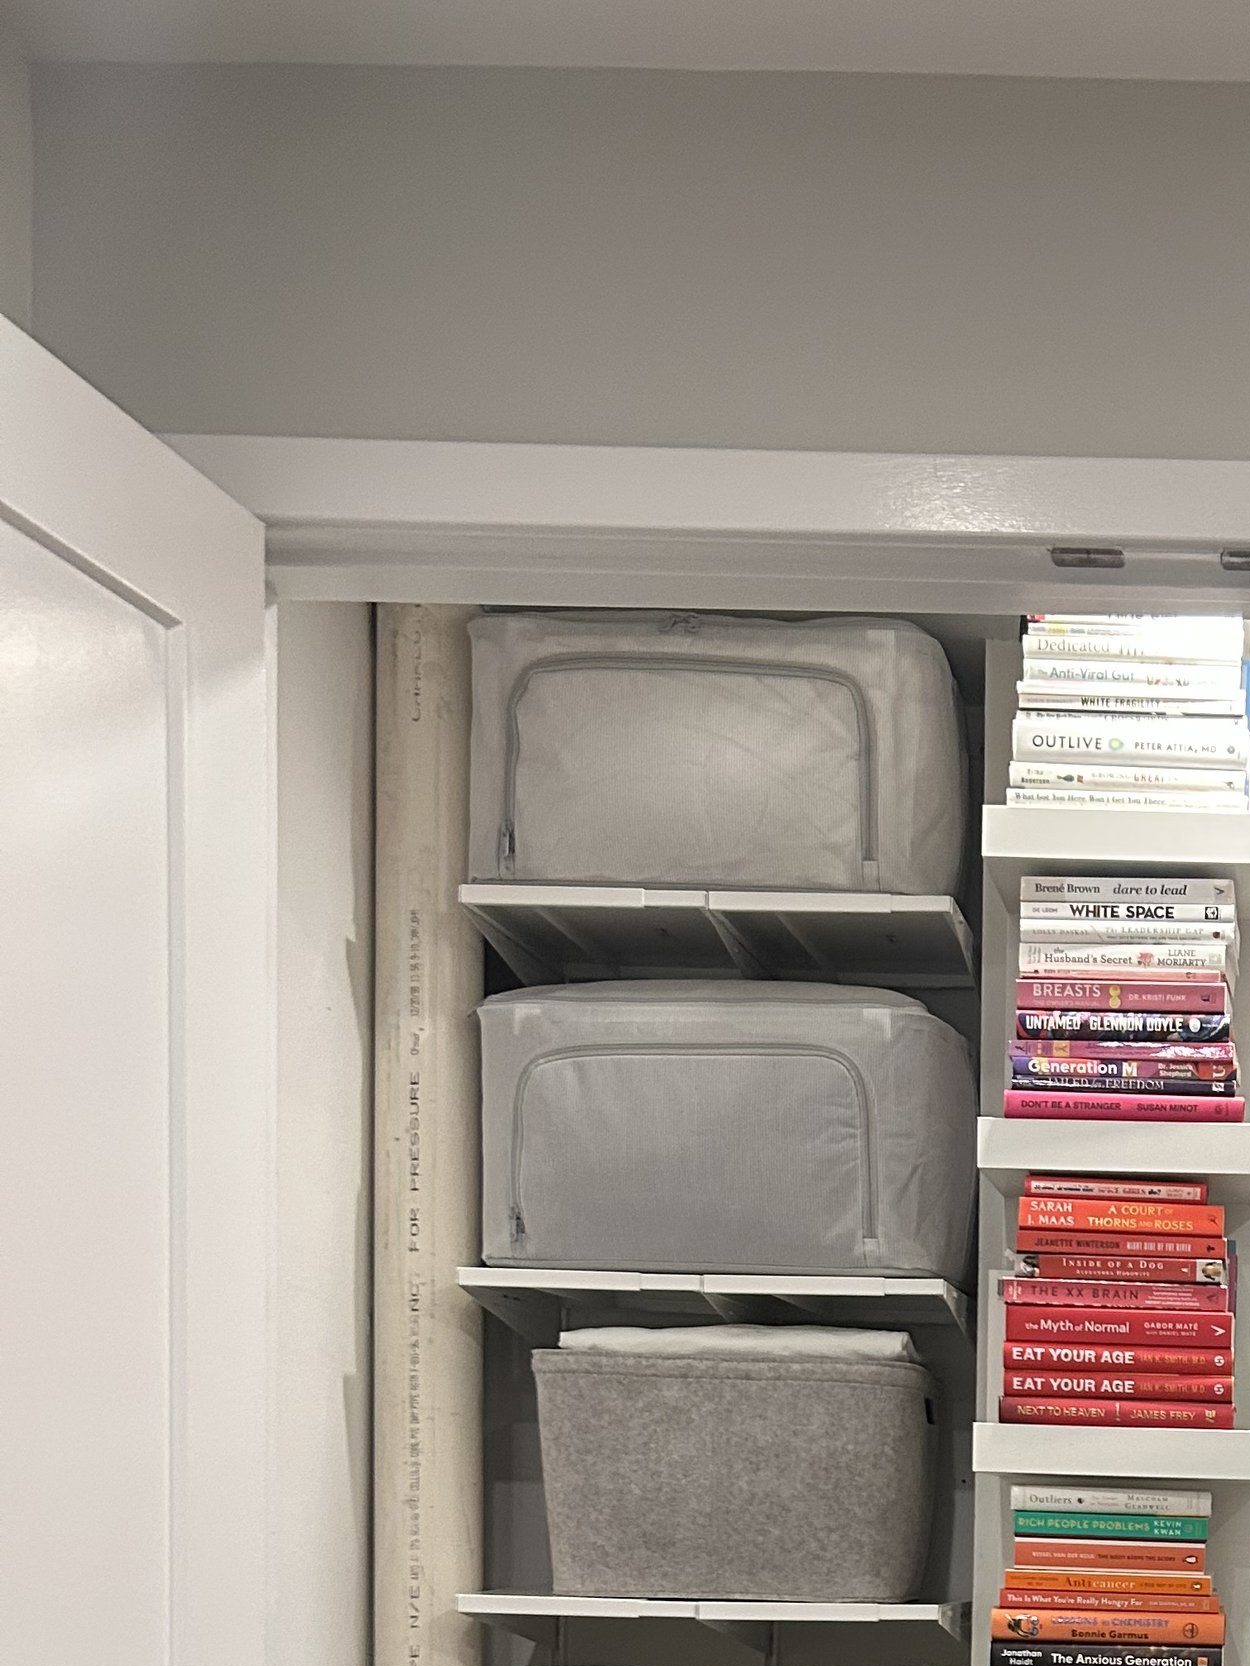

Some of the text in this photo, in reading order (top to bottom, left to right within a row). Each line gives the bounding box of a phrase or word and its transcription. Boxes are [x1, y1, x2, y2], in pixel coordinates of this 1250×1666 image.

[1050, 667, 1108, 681] Anti-Viral
[1032, 735, 1102, 750] OUTLIVE
[1135, 742, 1162, 751] PETER
[1202, 745, 1217, 753] MD
[1067, 883, 1100, 894] Brown
[1145, 885, 1188, 895] to lead
[1070, 904, 1174, 919] WHITE SPACE
[1100, 954, 1132, 964] Secret
[1157, 957, 1207, 967] MORIARTY
[1033, 984, 1101, 998] BREASTS
[1026, 1015, 1184, 1032] UNTAMED GLENNON DOYLE
[1028, 1059, 1138, 1077] Generation M
[408, 1071, 420, 1253] FOR PRESSURE
[1030, 1201, 1162, 1216] SARAH A COURT
[1039, 1216, 1193, 1230] MAAS THORNS ROSES
[1092, 1289, 1139, 1299] BRAIN
[1040, 1319, 1129, 1334] Myth of Normal
[1012, 1347, 1135, 1364] EAT YOUR AGE
[1012, 1377, 1135, 1393] EAT YOUR AGE
[1051, 1653, 1073, 1664] The
[1075, 1654, 1122, 1666] Anxious
